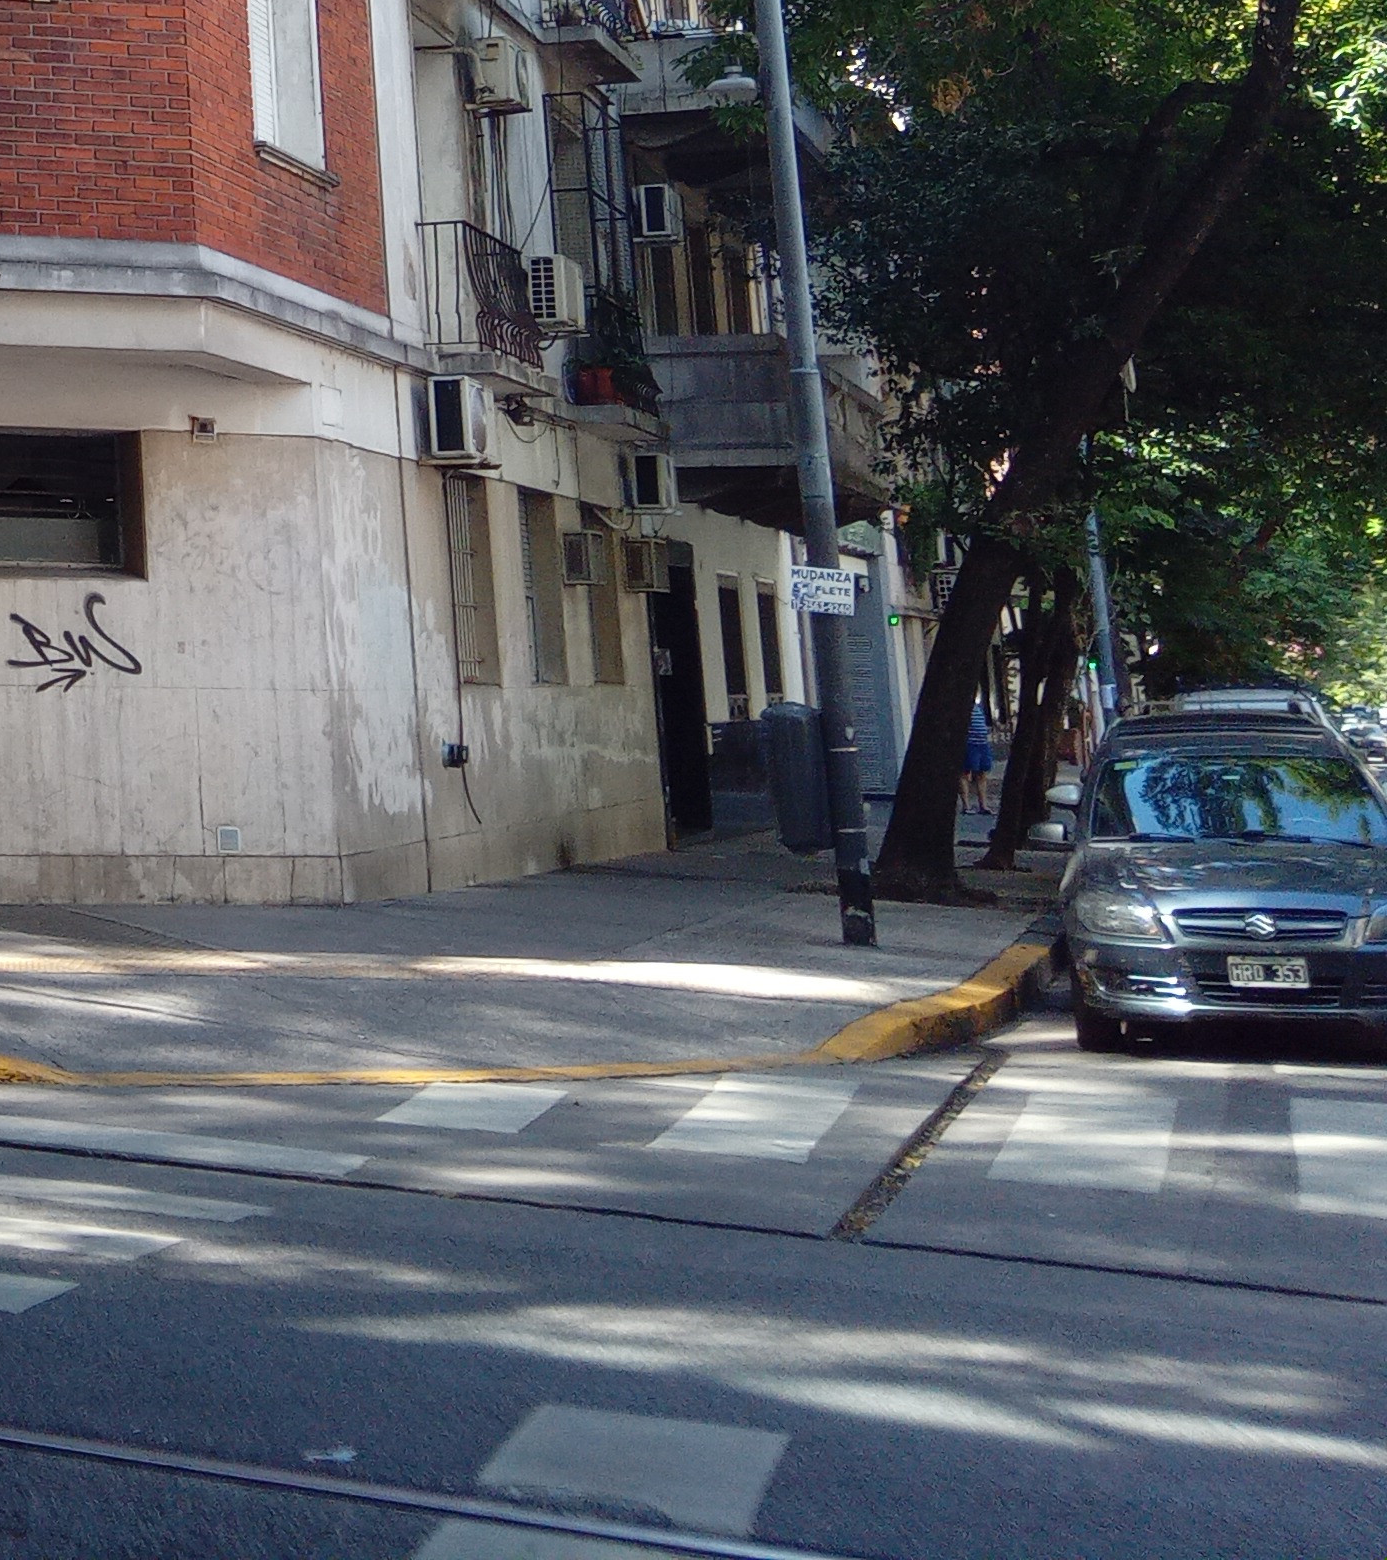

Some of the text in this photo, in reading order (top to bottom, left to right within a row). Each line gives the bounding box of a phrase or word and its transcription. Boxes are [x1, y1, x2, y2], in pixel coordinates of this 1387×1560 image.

[791, 569, 851, 583] MUDANZA
[815, 585, 851, 597] FLETE
[1272, 965, 1305, 982] 353
